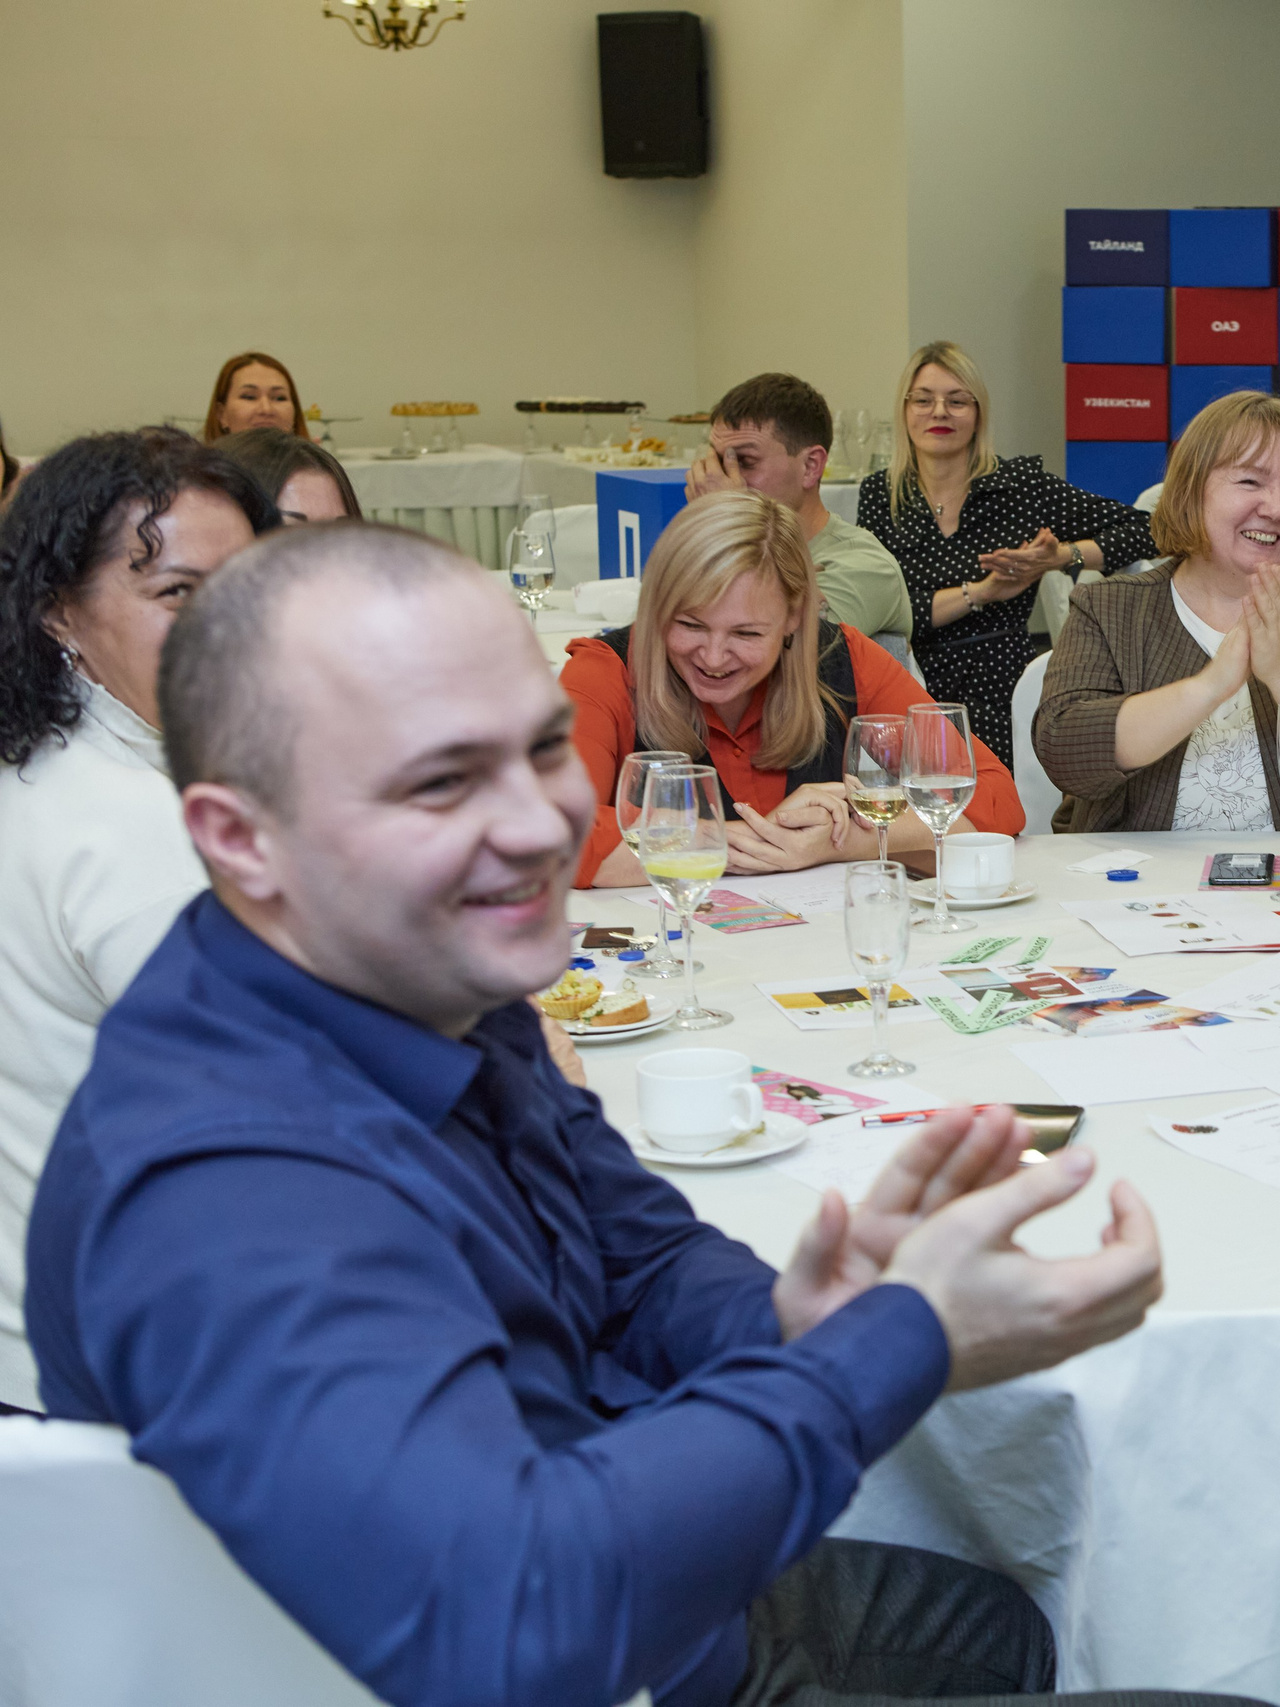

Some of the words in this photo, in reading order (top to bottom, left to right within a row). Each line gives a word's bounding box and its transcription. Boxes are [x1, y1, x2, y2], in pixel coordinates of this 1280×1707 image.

[1088, 238, 1145, 253] ТАЙЛАНД
[1210, 320, 1240, 333] ОАЭ
[1083, 396, 1151, 409] УЗБЕКИСТАН
